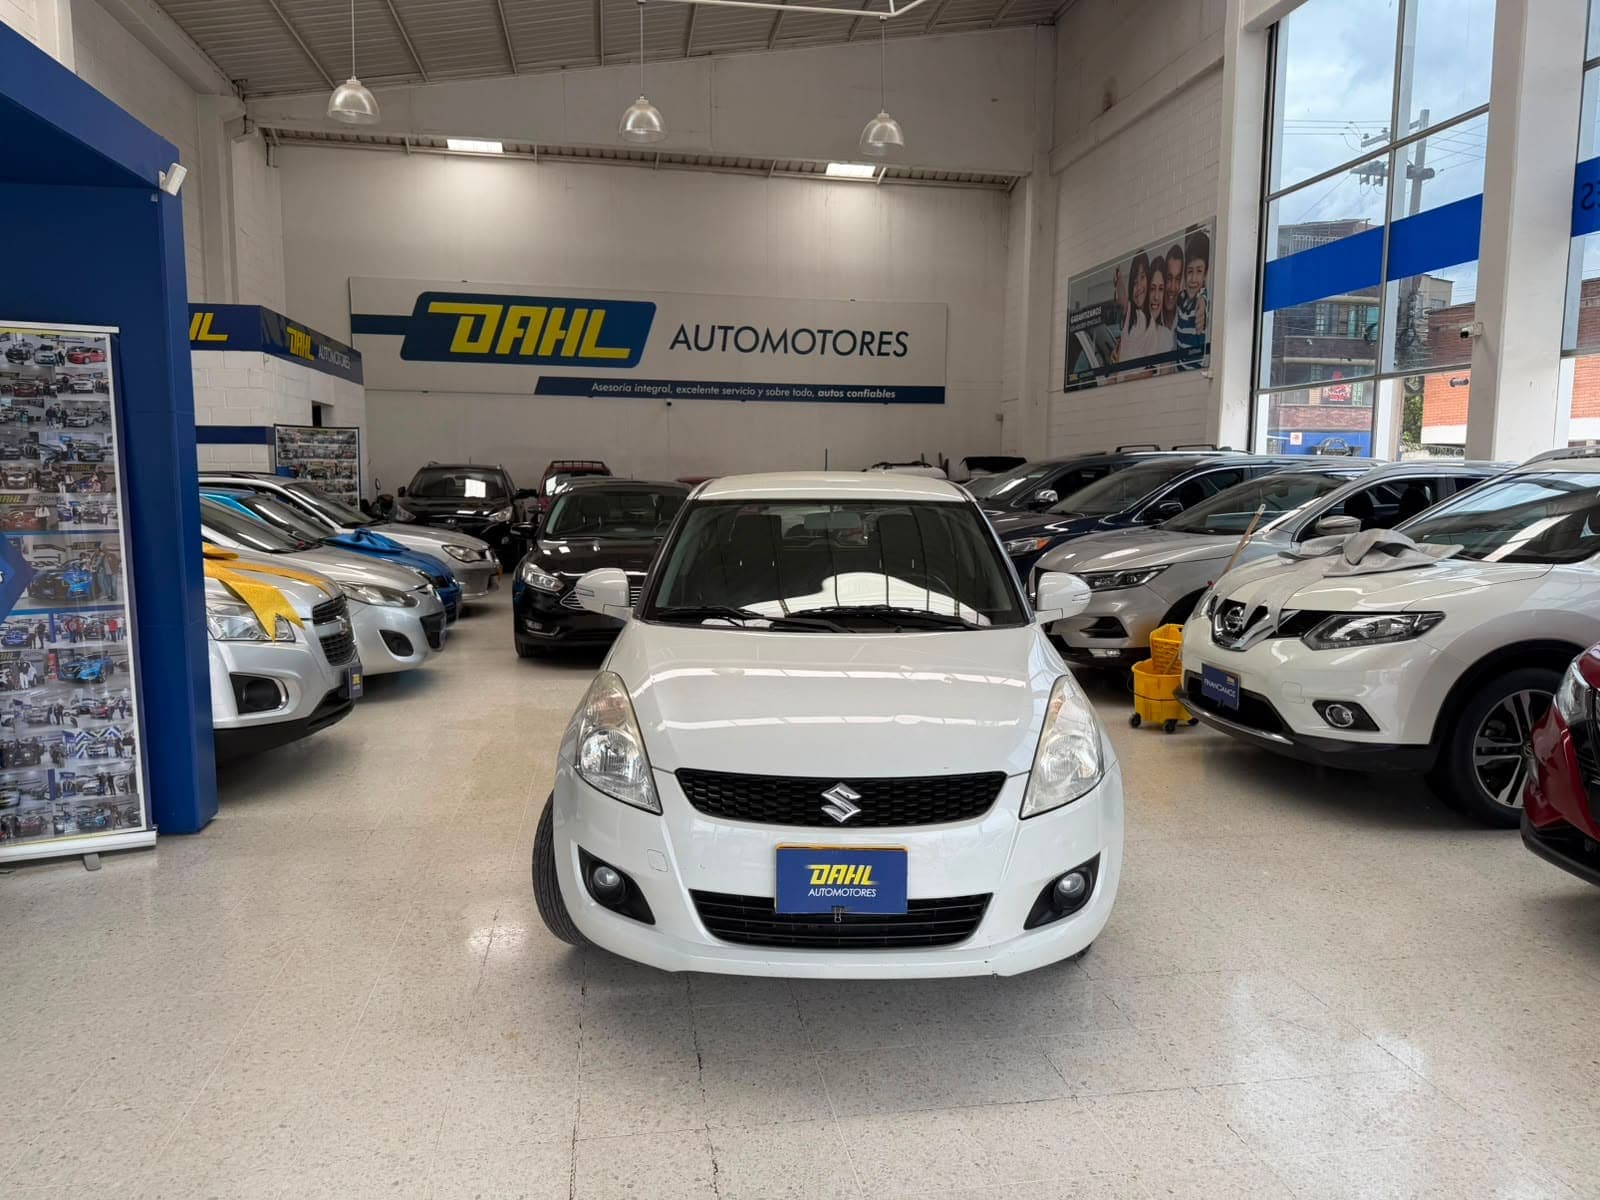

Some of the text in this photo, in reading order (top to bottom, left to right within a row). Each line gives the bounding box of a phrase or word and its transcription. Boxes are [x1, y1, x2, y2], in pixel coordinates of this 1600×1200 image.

[428, 302, 909, 359] DAHL AUTOMOTORES
[286, 326, 315, 361] DAHL
[634, 384, 673, 395] integral,
[676, 385, 720, 395] excelente
[722, 387, 756, 396] servicio
[757, 389, 763, 397] y
[766, 387, 790, 397] sobre
[792, 388, 815, 398] todo,
[818, 389, 844, 398] autos
[847, 389, 896, 399] confiables
[805, 864, 880, 885] DAHL
[808, 887, 877, 898] AUTOMOTORES
